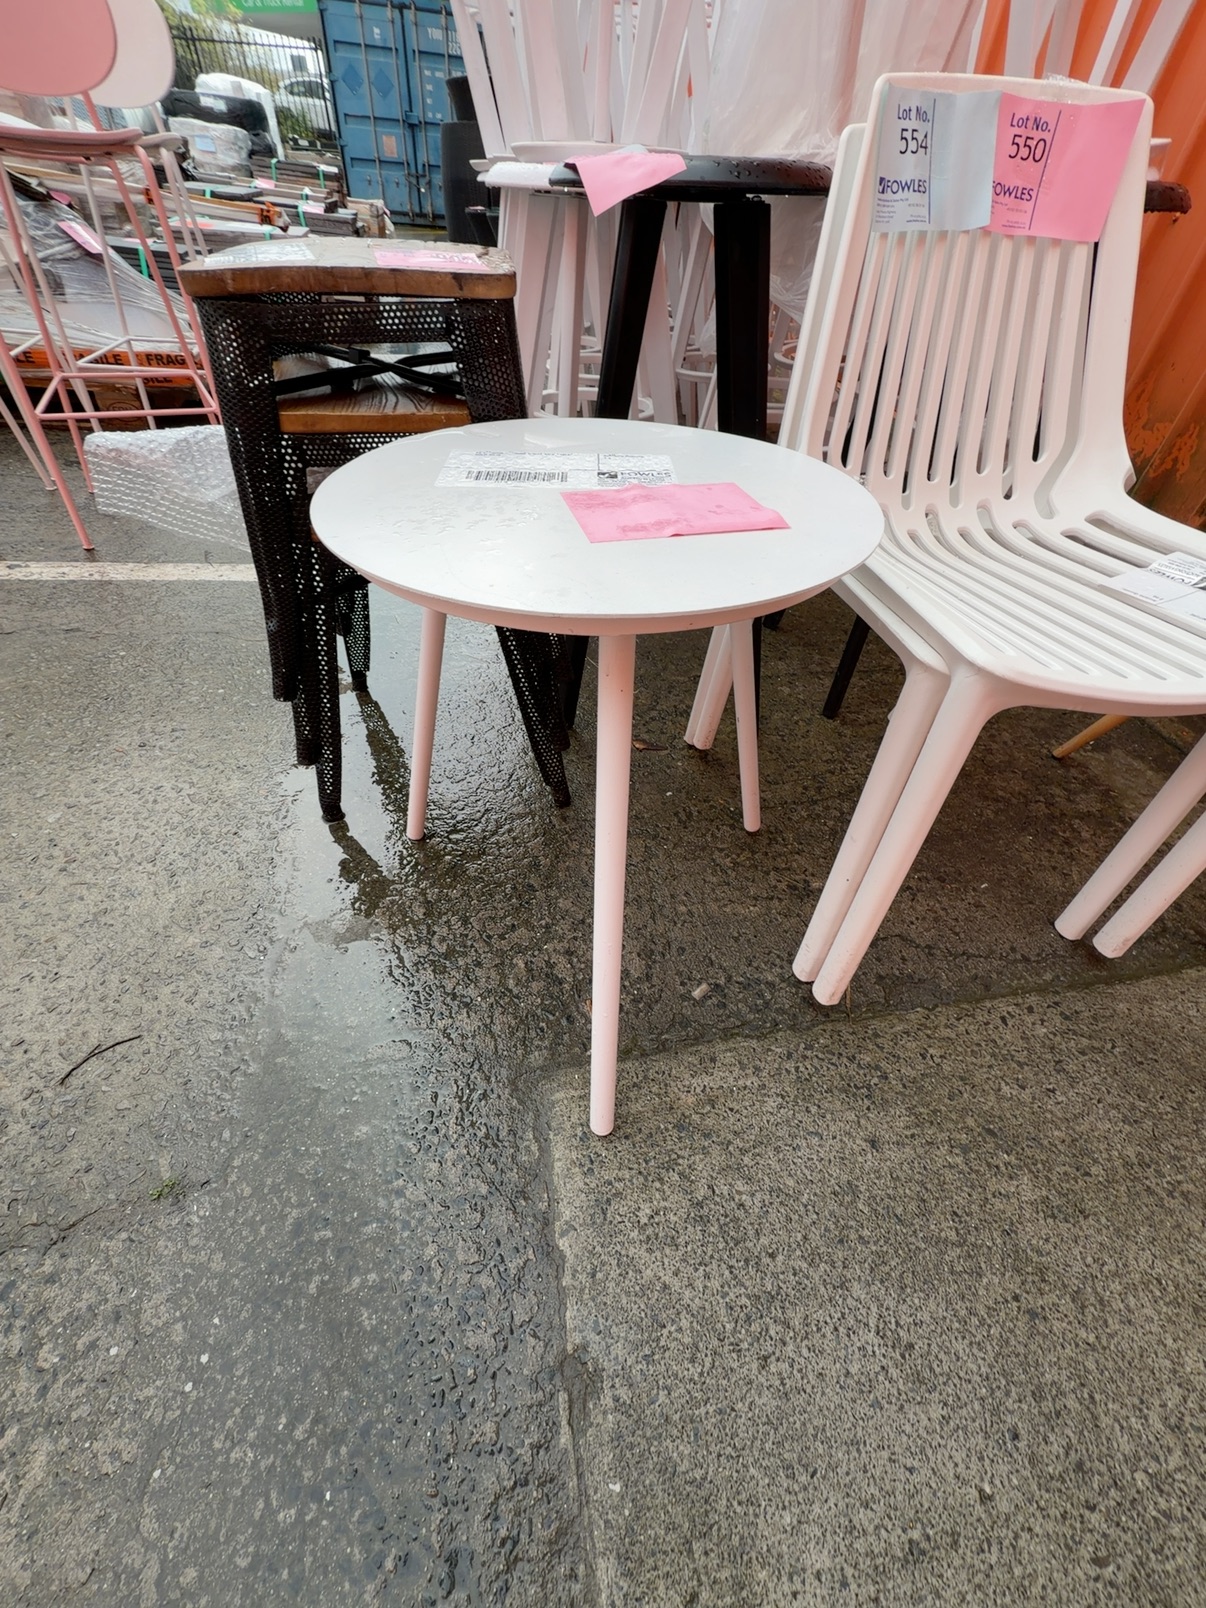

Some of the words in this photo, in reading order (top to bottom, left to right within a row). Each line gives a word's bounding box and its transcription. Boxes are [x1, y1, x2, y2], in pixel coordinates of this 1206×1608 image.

[897, 104, 912, 121] Lot
[915, 105, 931, 123] No.
[1010, 112, 1030, 130] Lot
[1031, 117, 1052, 133] No.
[899, 127, 929, 155] 554
[1008, 134, 1047, 163] 550
[886, 179, 927, 195] FOWLES
